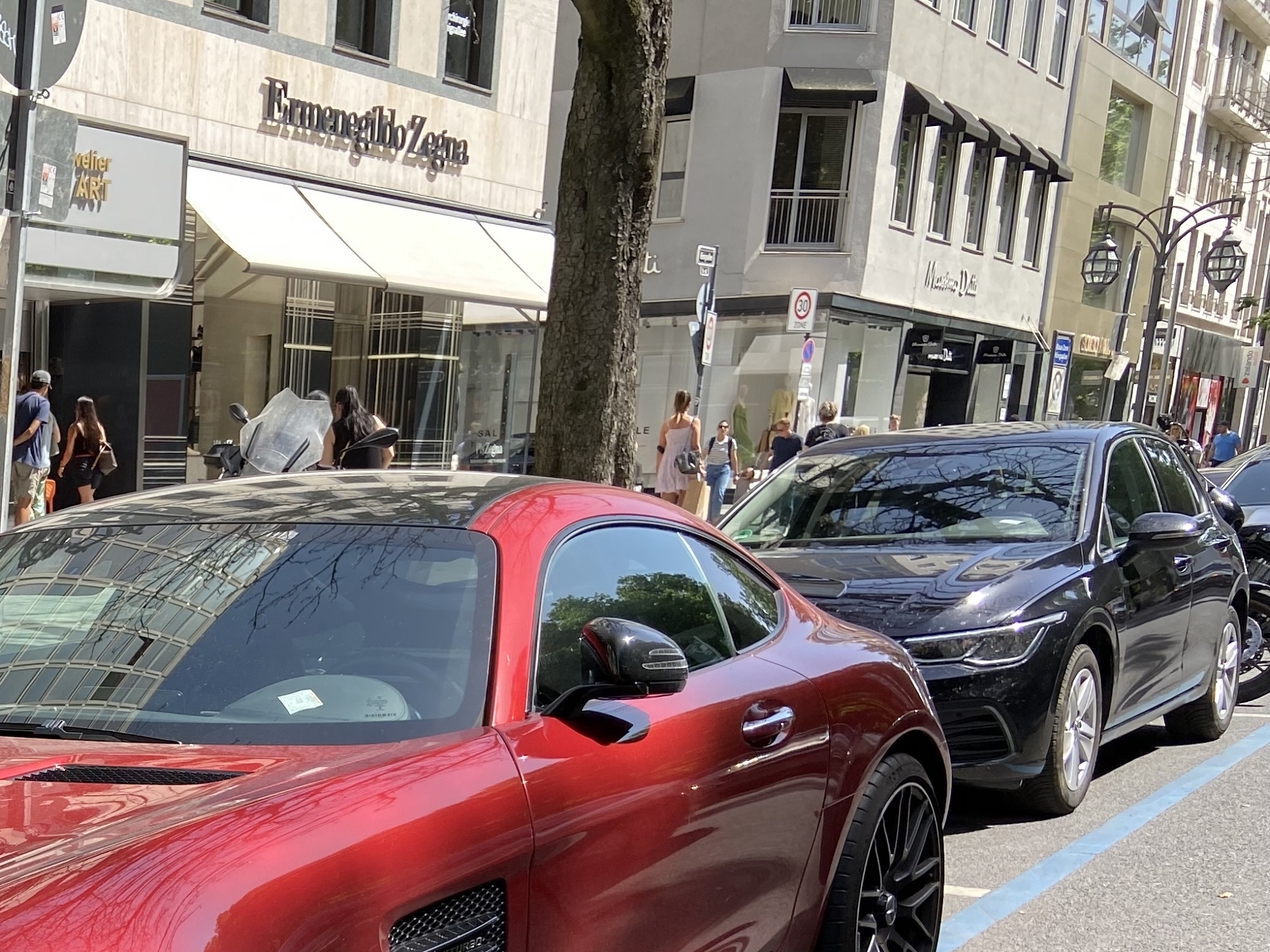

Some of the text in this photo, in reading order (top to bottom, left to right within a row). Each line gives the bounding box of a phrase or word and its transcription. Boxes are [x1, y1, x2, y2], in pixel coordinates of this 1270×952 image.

[264, 76, 470, 171] Ermenegildo Zegna
[75, 176, 112, 201] ART
[643, 251, 662, 274] ti
[797, 299, 809, 313] 30
[793, 321, 808, 329] ZONE
